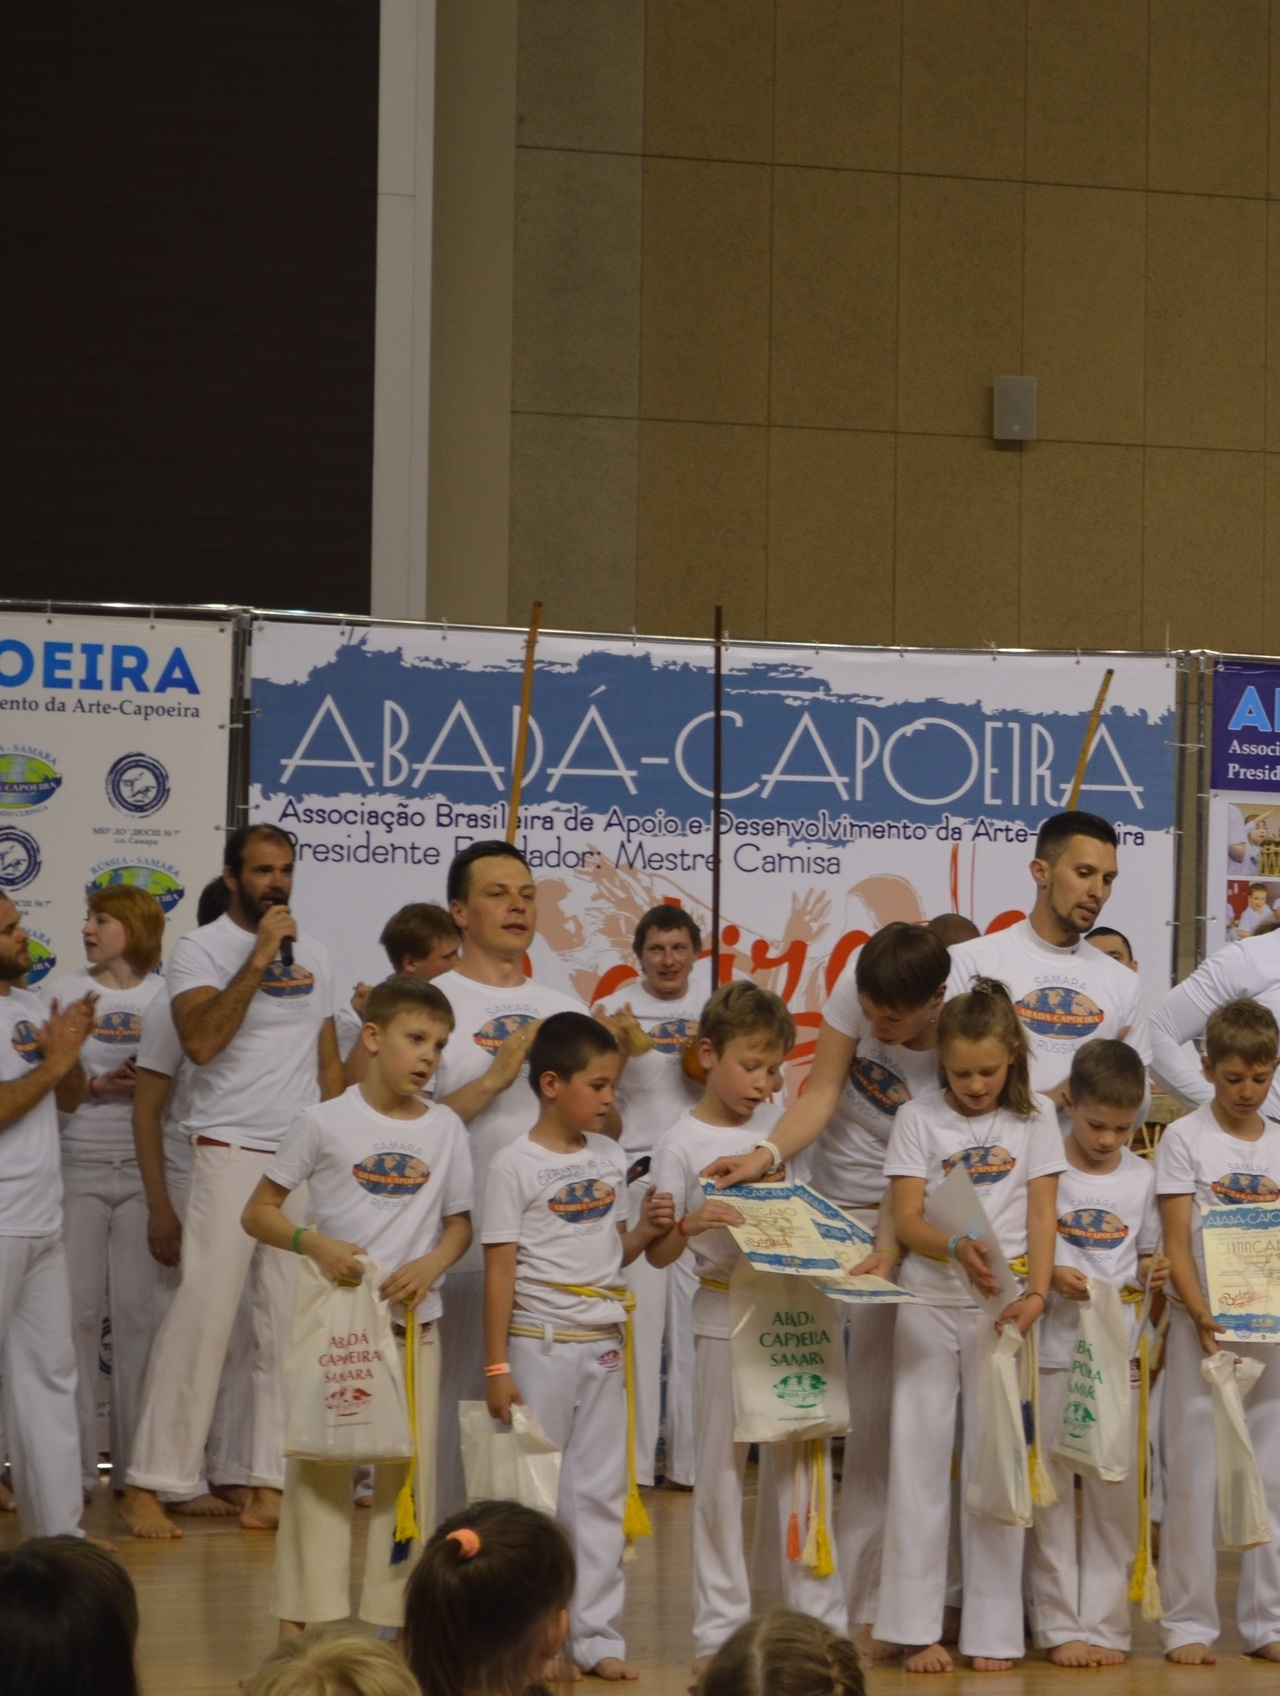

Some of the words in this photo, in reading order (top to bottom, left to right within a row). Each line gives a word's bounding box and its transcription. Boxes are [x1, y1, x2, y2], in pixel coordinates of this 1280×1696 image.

[45, 697, 66, 713] da
[72, 699, 200, 720] Arte-Capoeira
[13, 744, 57, 766] SAMARA
[279, 683, 1144, 810] ABADÁ-CAPOEIRA
[5, 780, 57, 793] CAPOEIRA
[279, 798, 425, 834] Associação
[564, 805, 594, 832] de
[603, 805, 679, 843] Apoio
[688, 817, 703, 834] e
[711, 808, 928, 841] Desenvolvimento
[936, 812, 963, 842] da
[972, 817, 1145, 847] Arte-ira
[136, 856, 181, 878] SAMARA
[615, 841, 723, 872] Mestre
[734, 842, 841, 875] Camisa
[1034, 975, 1087, 992] SAMARA
[485, 1003, 540, 1017] SAMARA
[372, 1142, 422, 1156] SAMARA
[1228, 1163, 1271, 1174] SAMARA
